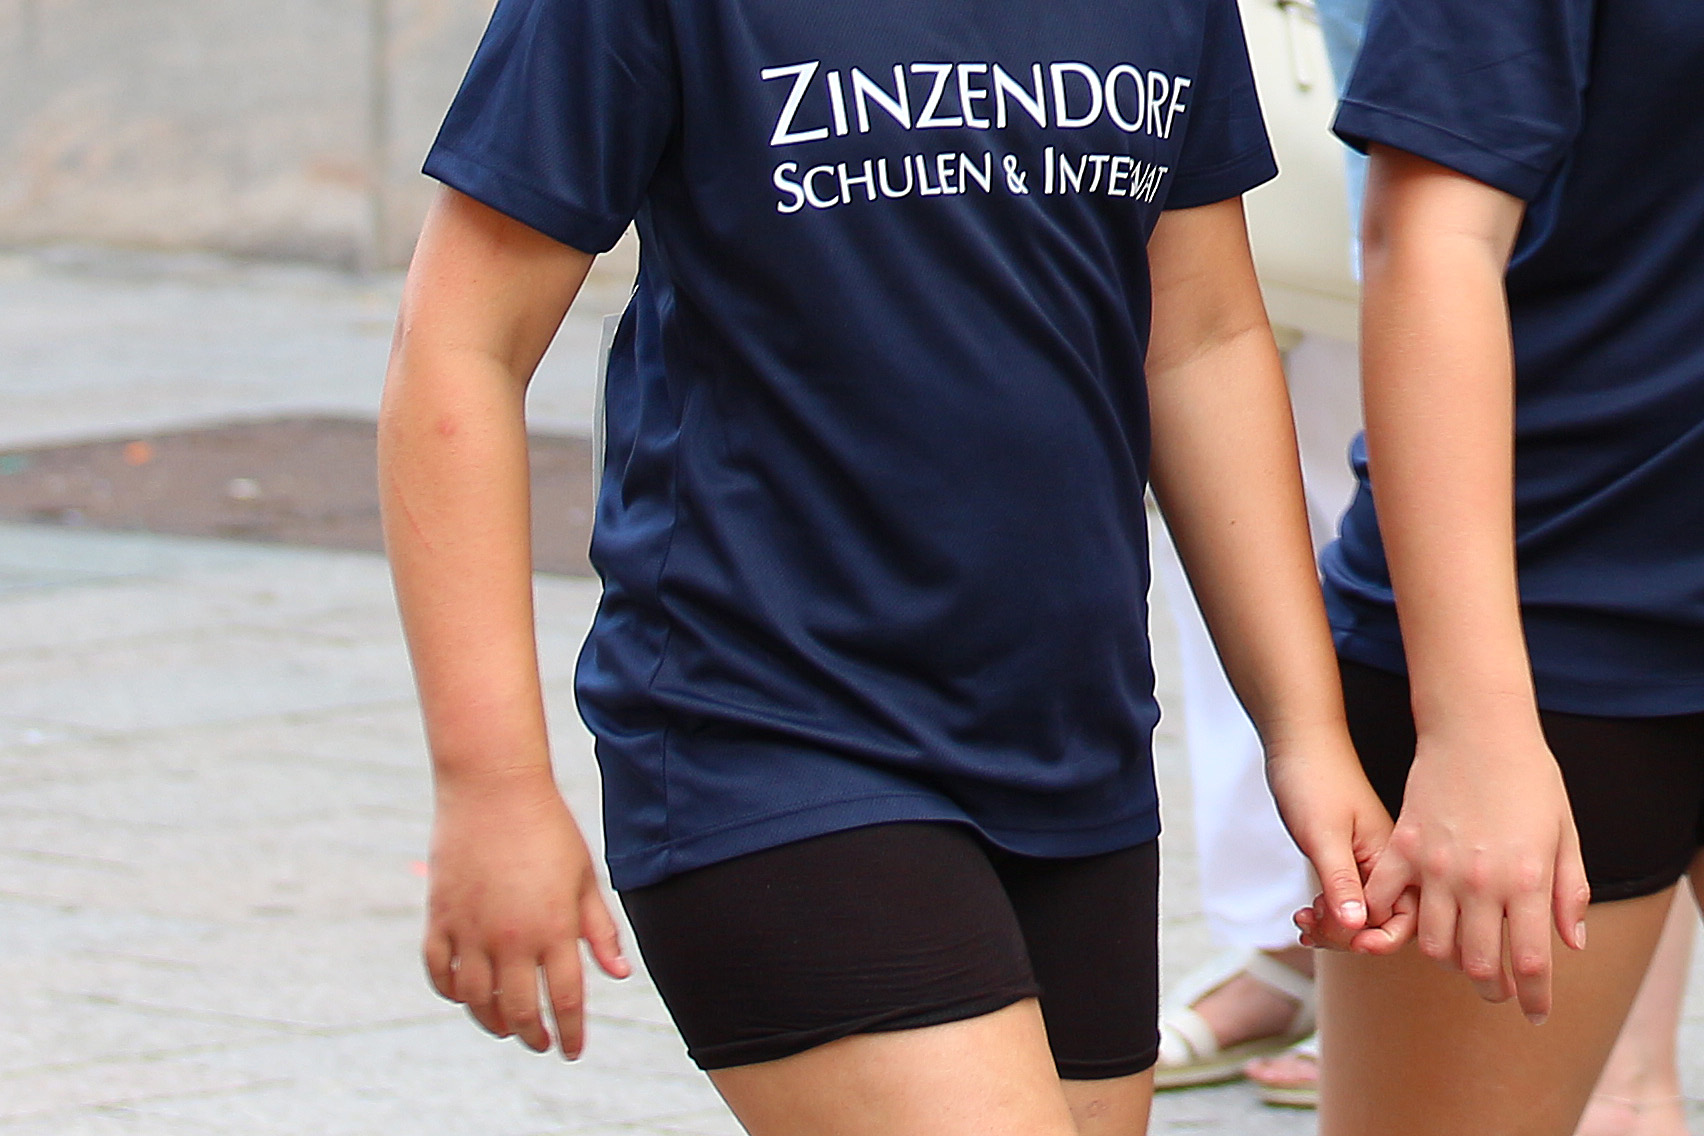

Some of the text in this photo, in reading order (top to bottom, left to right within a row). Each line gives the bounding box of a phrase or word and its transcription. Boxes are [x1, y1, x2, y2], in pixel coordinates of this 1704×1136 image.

[760, 60, 1192, 147] ZINZENDORF
[772, 150, 992, 214] SCHULEN
[1003, 153, 1030, 195] &
